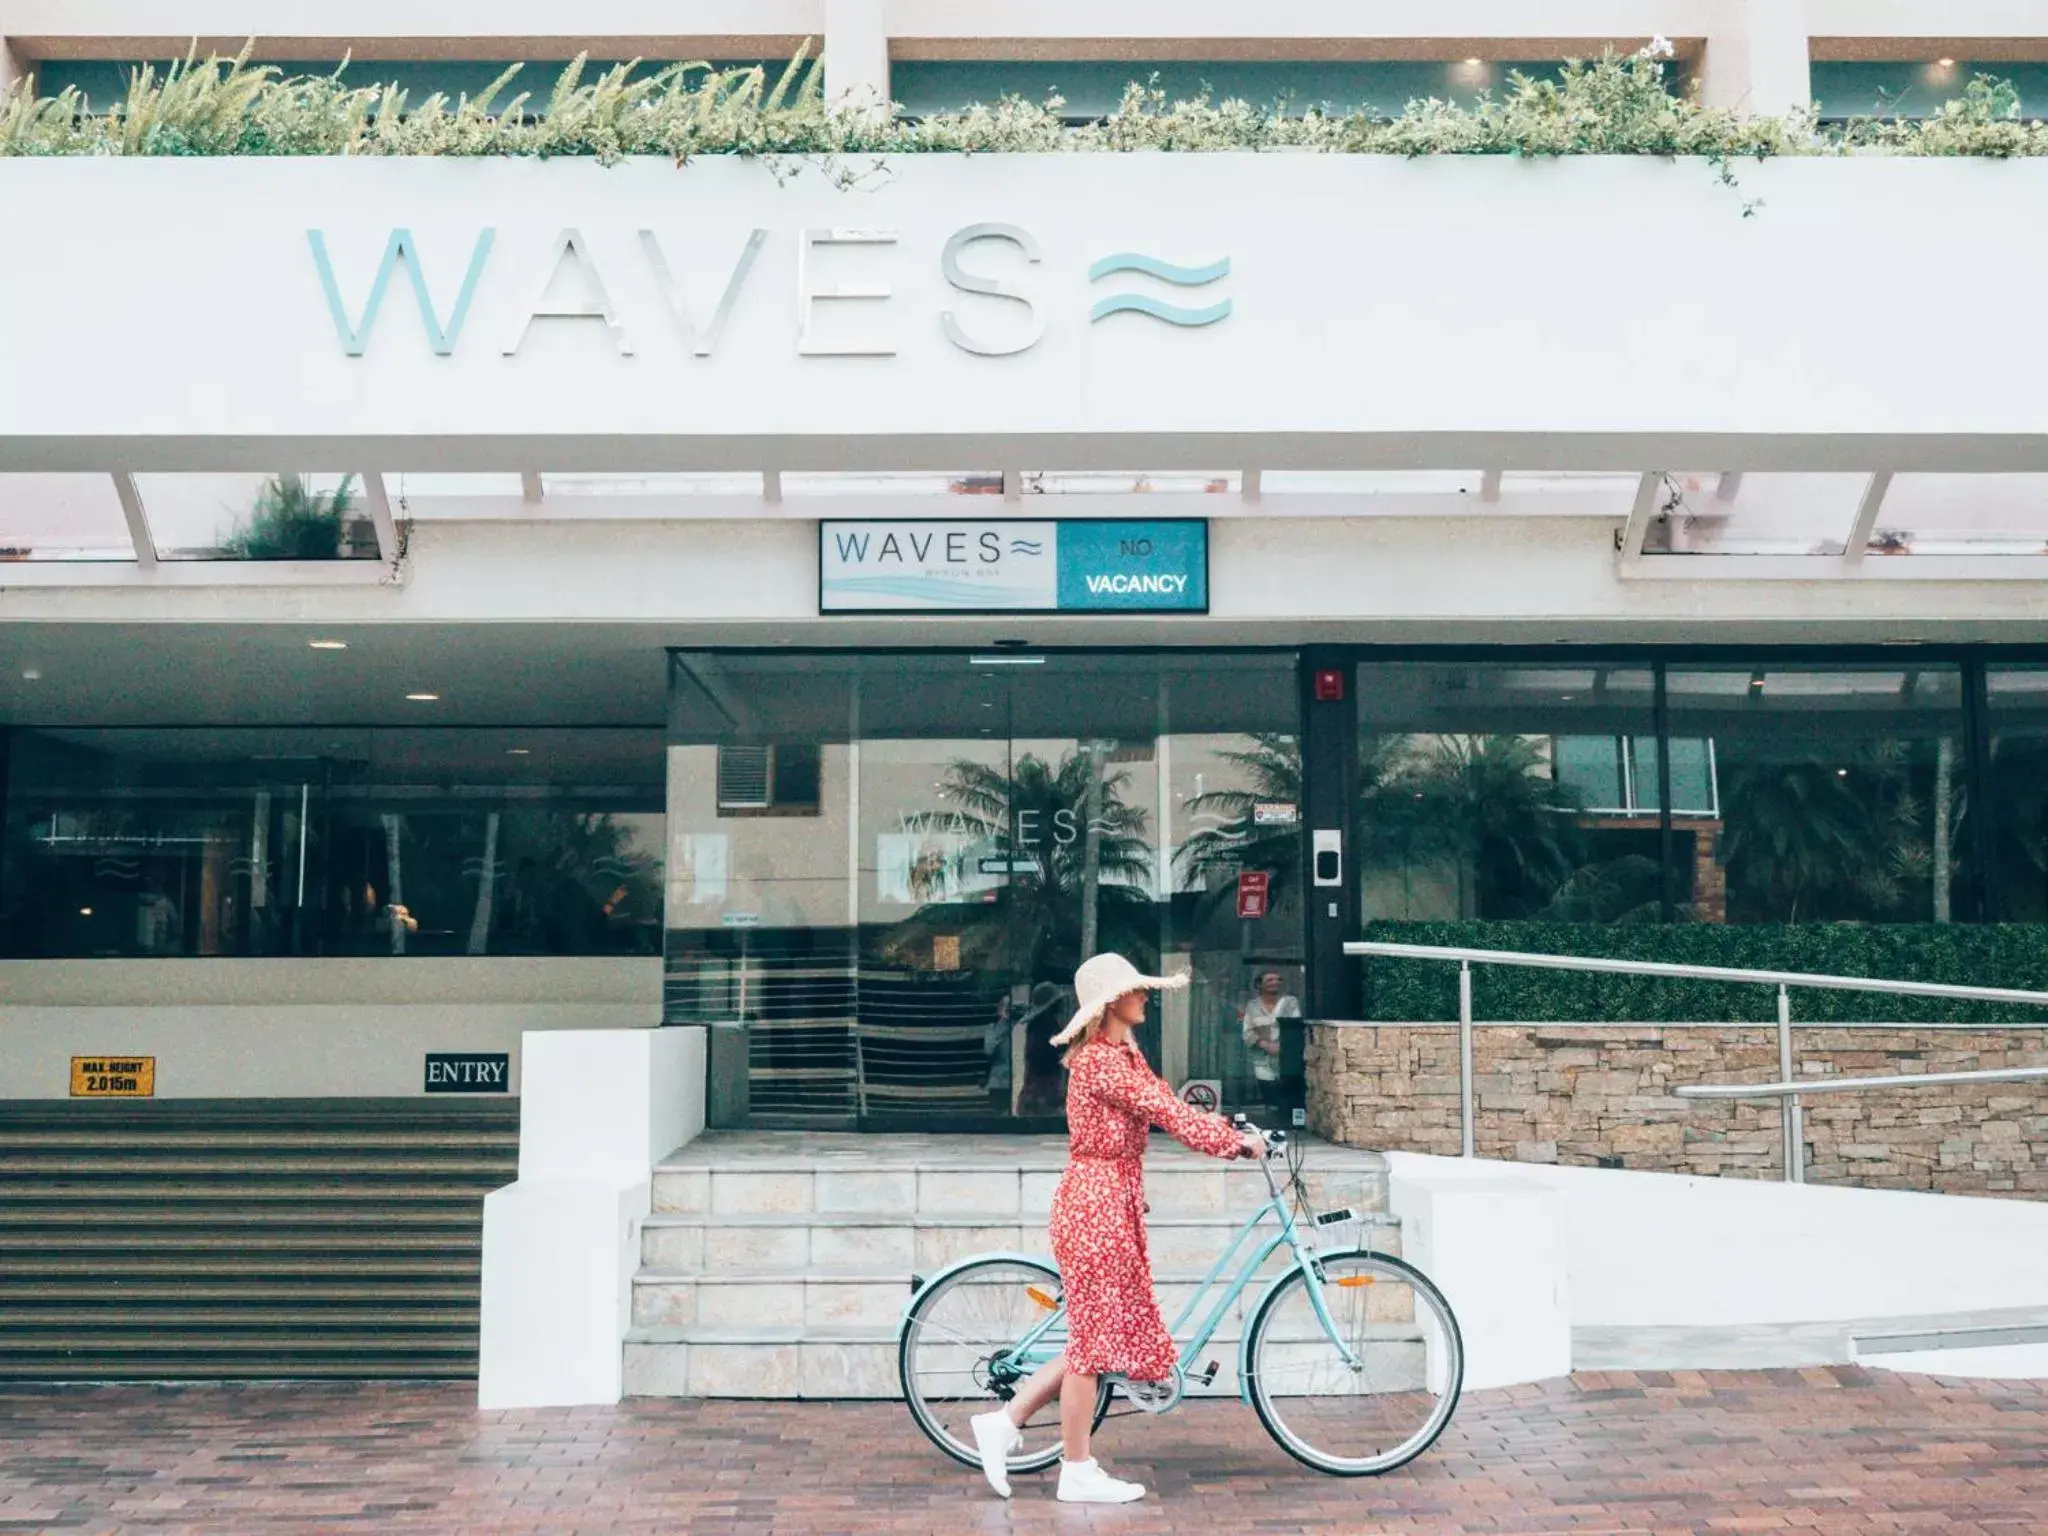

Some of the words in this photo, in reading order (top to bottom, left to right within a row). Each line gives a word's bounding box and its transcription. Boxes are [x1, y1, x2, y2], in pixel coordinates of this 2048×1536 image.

[306, 222, 1046, 358] WAVES
[836, 532, 1001, 563] WAVES
[1119, 538, 1153, 557] NO
[1086, 574, 1188, 594] VACANCY
[898, 809, 1078, 844] WAVES
[109, 1062, 143, 1073] HEIGHT
[428, 1061, 505, 1082] ENTRY
[87, 1076, 137, 1091] 2.015m
